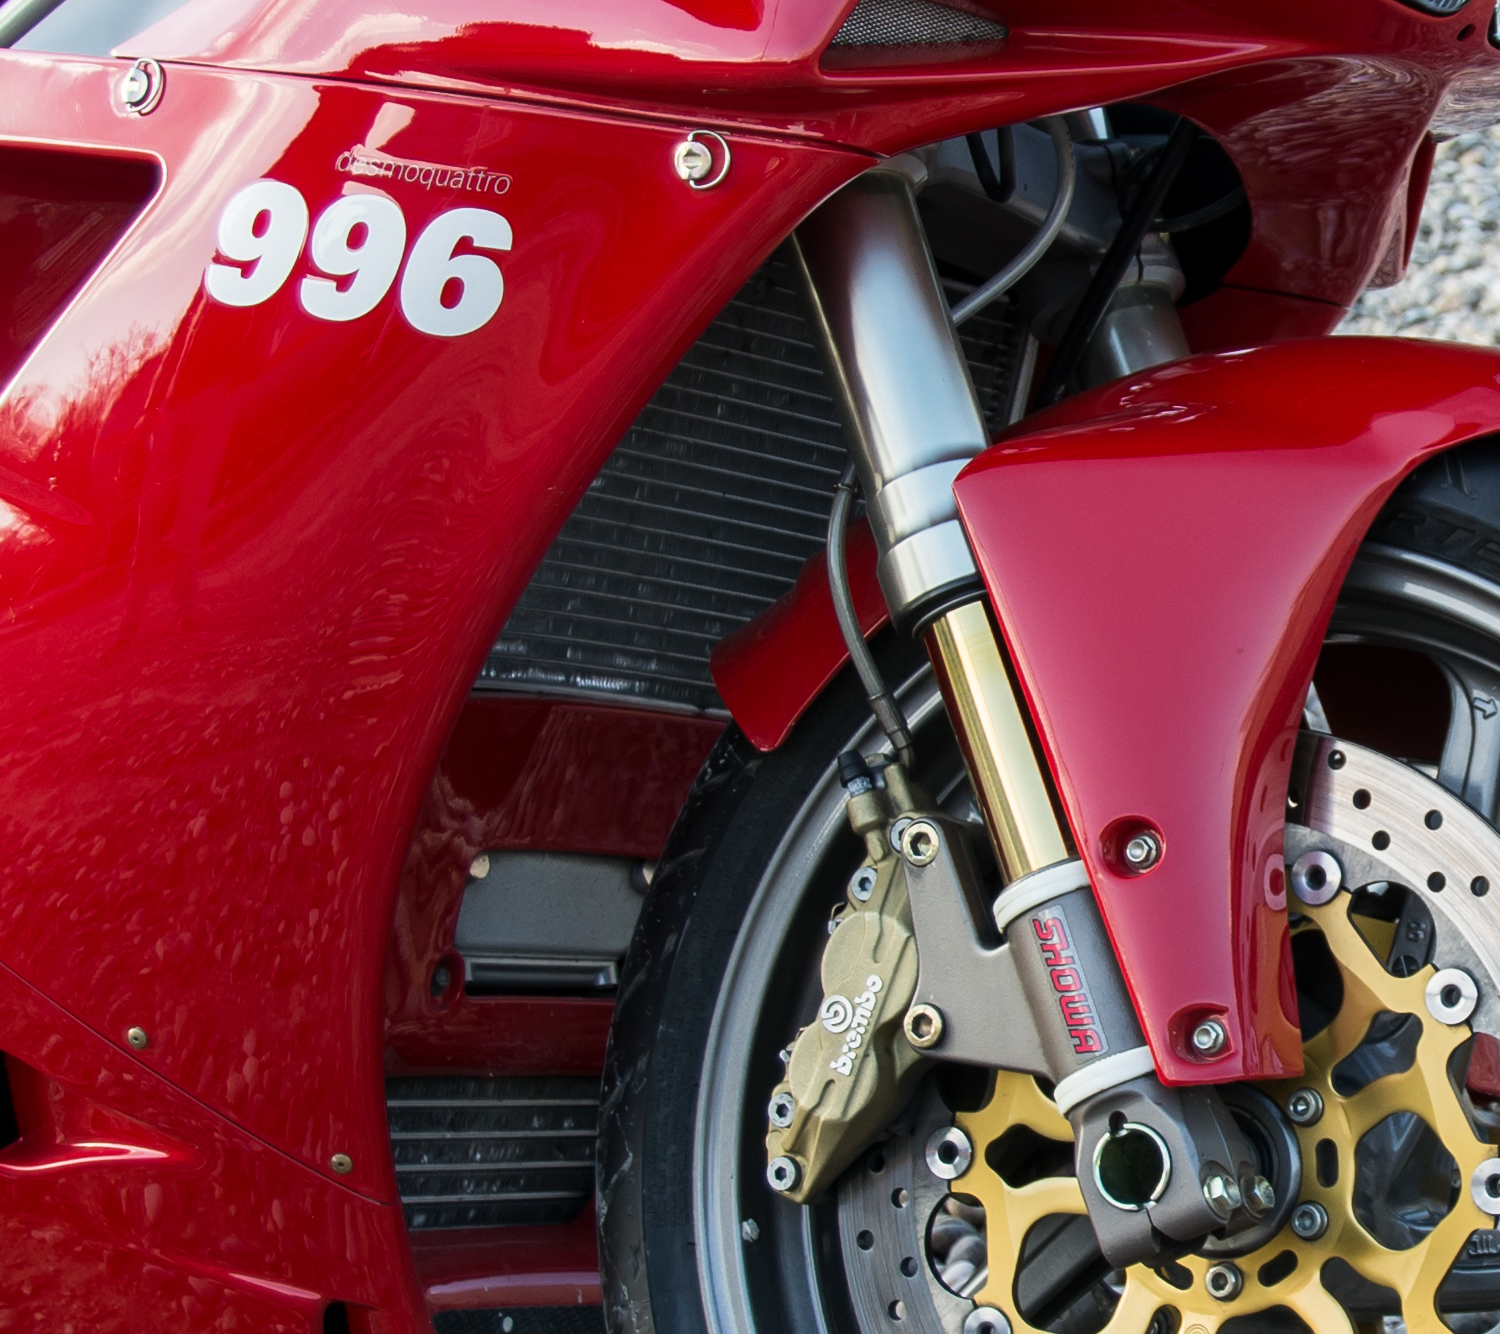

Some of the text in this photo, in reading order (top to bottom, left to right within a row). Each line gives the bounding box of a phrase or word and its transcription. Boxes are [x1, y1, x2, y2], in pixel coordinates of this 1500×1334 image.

[336, 150, 513, 196] desmoquattro
[204, 179, 514, 338] 996
[830, 974, 883, 1076] brembo
[1032, 917, 1104, 1055] SHOWA
